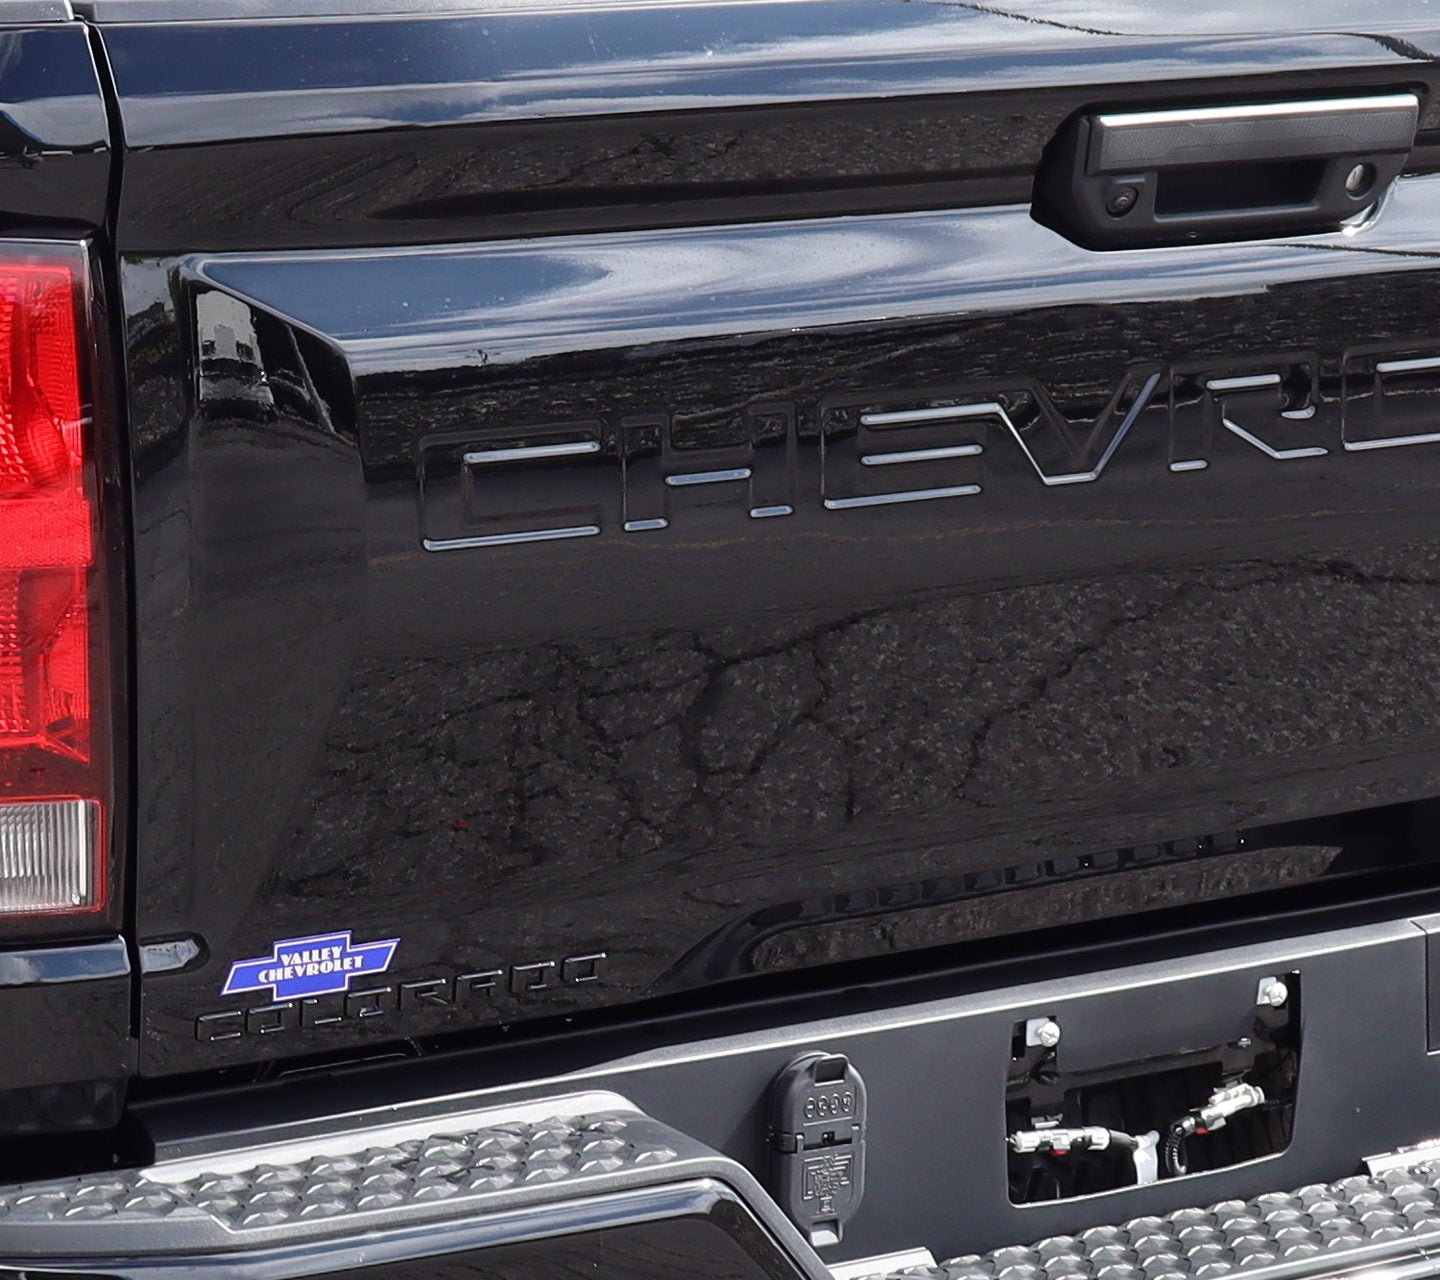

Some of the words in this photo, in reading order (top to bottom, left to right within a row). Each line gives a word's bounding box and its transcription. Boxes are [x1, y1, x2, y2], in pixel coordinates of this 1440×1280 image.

[258, 955, 364, 983] CHEVROLET
[280, 946, 343, 966] VALLEY
[196, 952, 608, 1042] COLORADO
